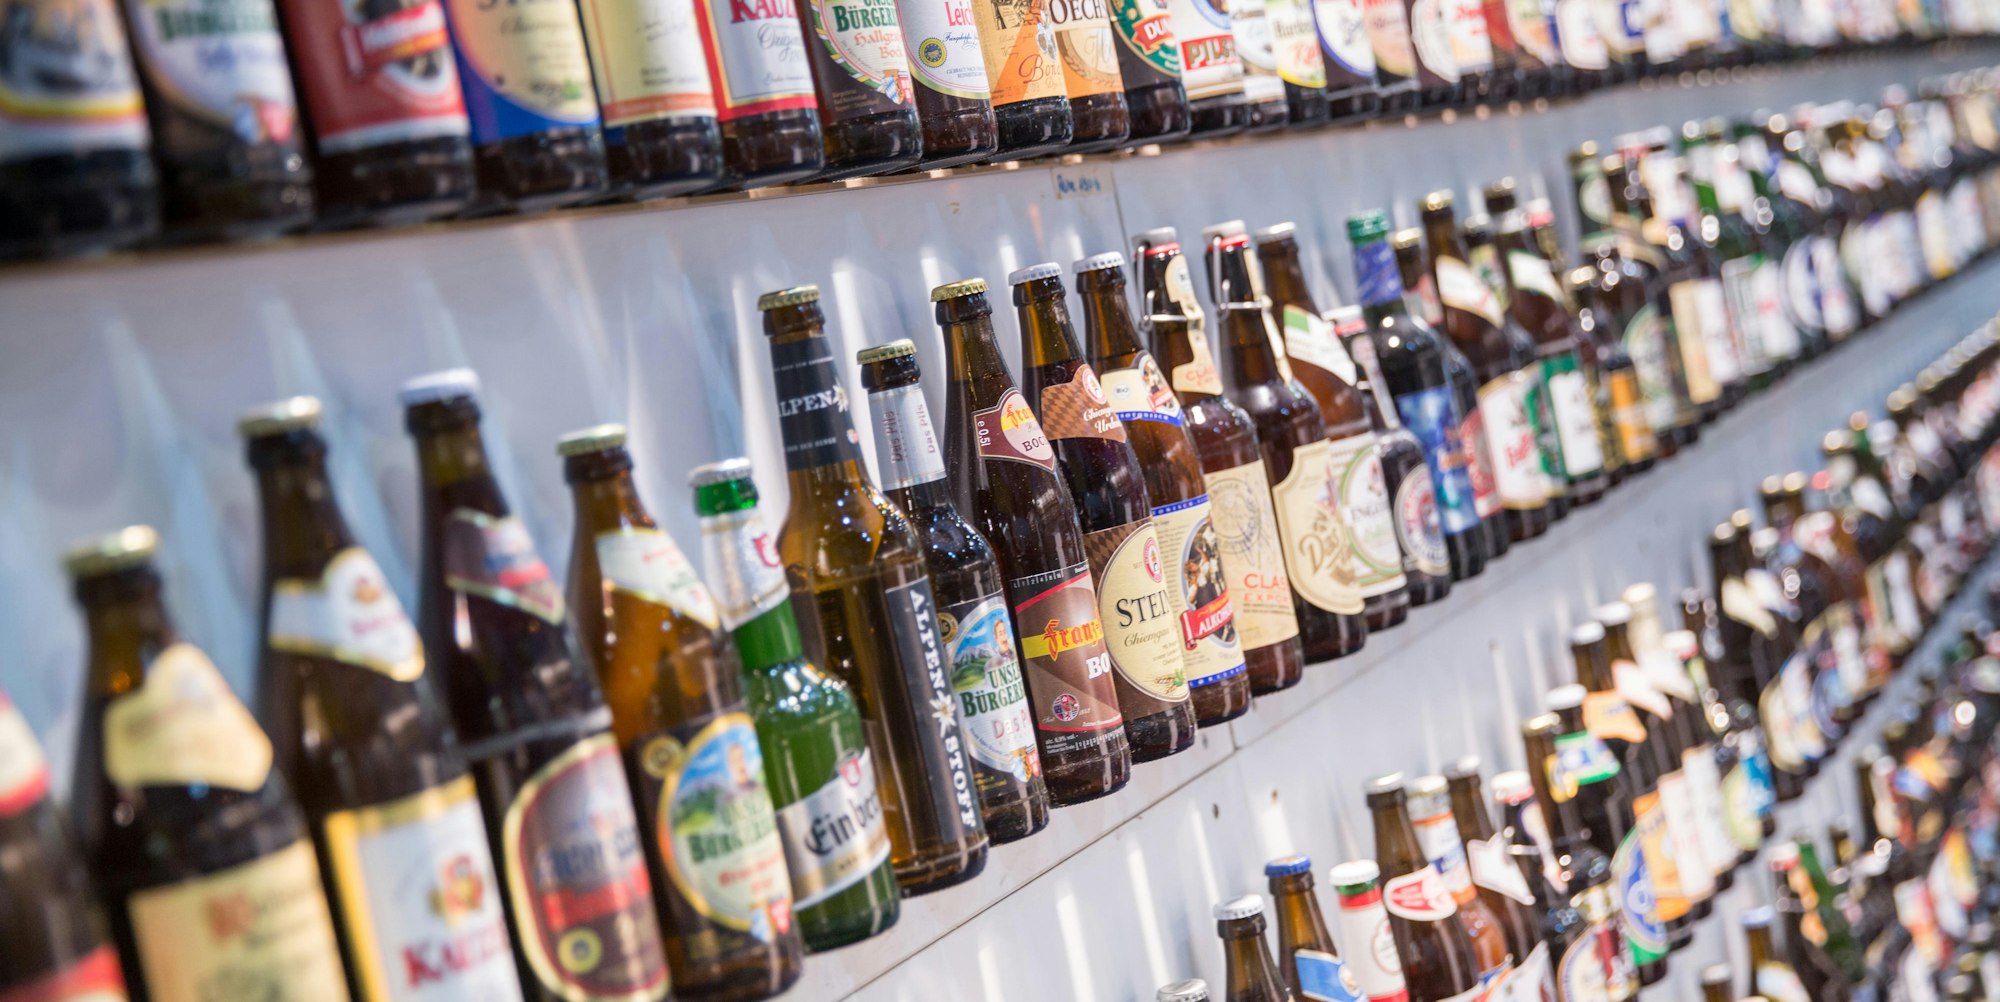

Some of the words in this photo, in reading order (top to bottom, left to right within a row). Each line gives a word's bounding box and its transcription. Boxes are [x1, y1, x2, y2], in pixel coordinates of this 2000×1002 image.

[778, 390, 834, 417] LPEN
[909, 589, 946, 690] ALPEN
[944, 735, 977, 828] STOFF
